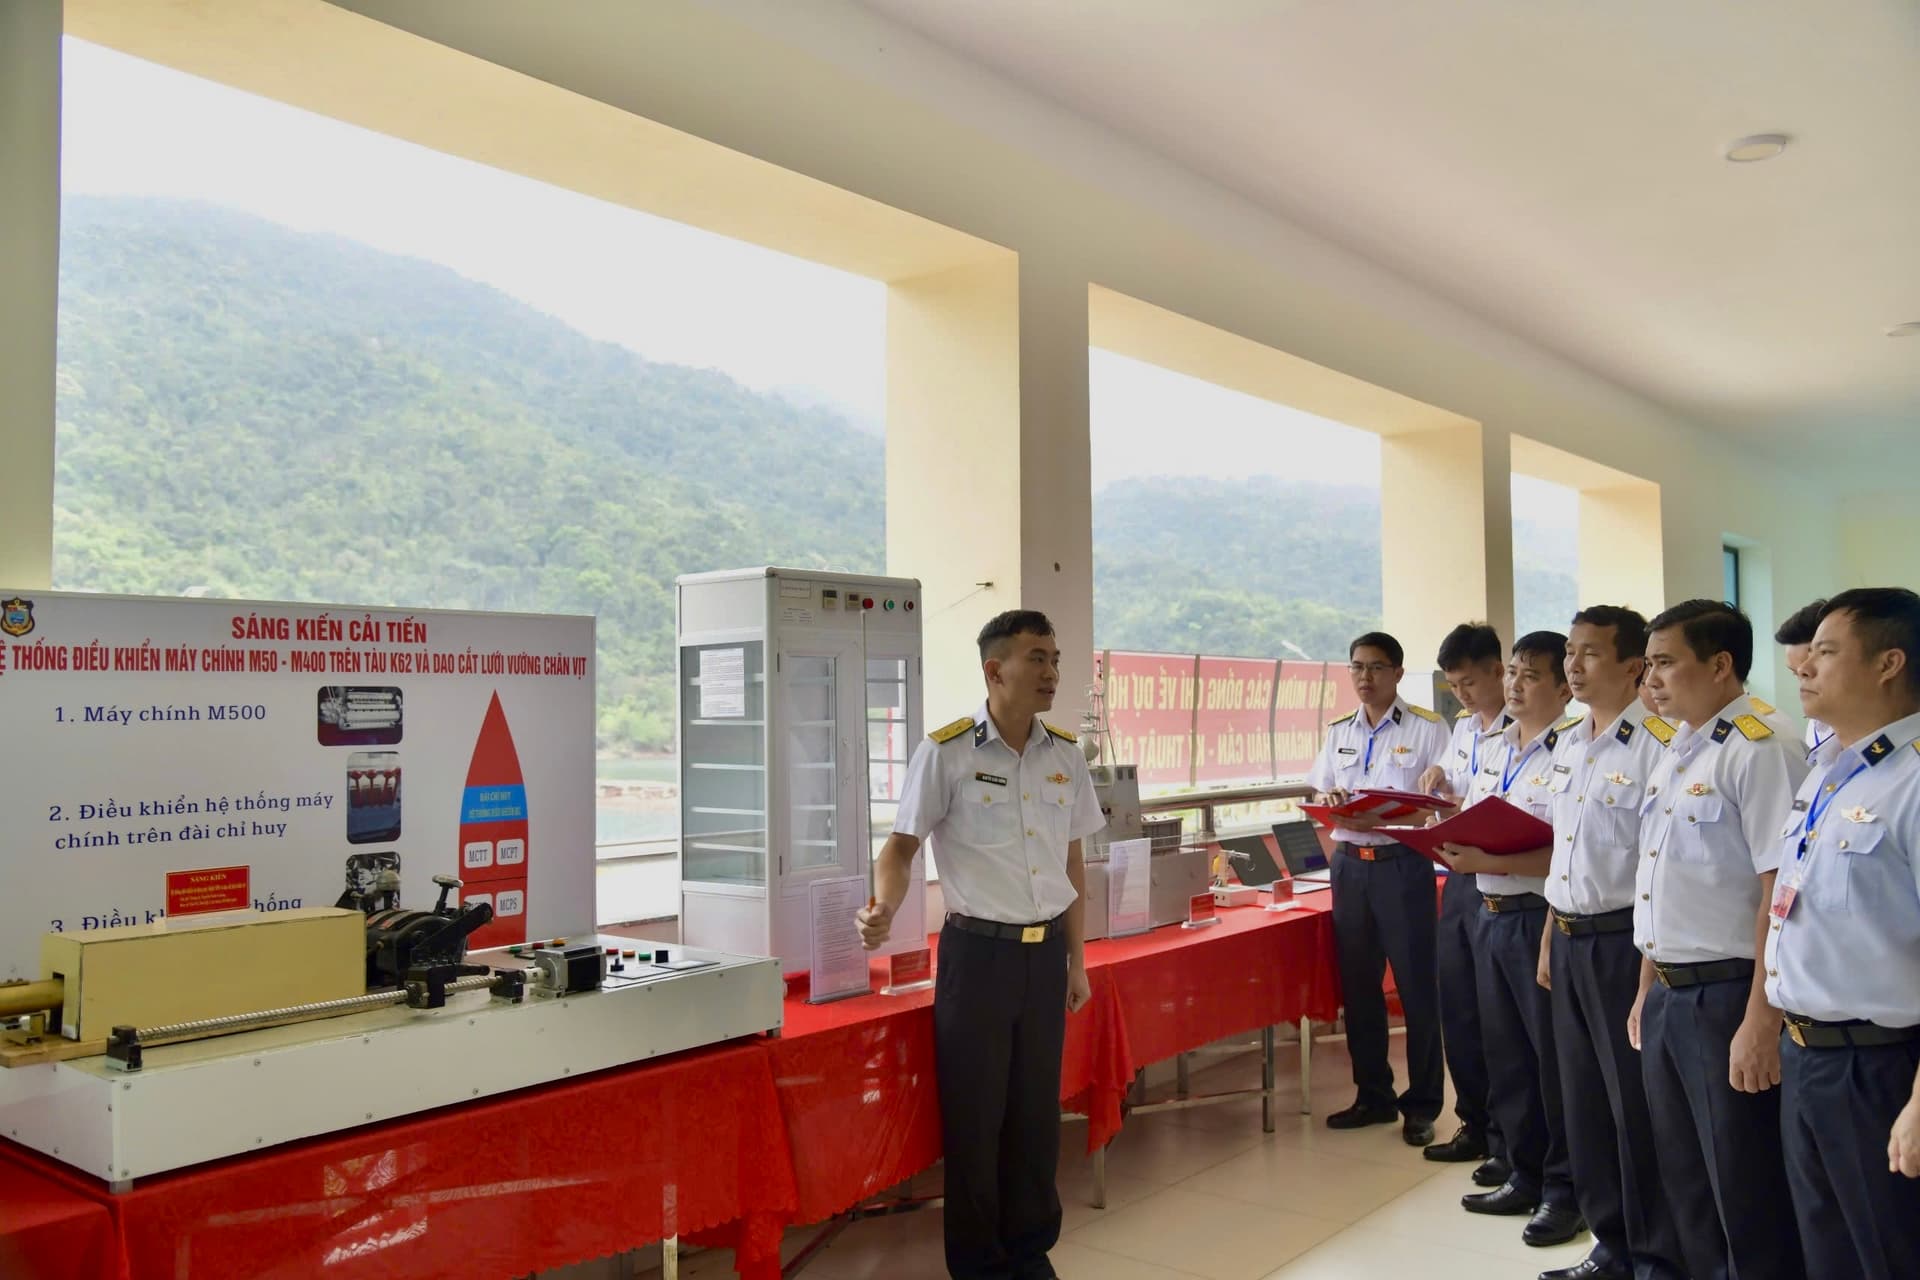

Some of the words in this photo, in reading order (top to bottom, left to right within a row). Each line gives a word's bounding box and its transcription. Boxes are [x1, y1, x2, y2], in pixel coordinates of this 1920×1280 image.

[231, 612, 290, 641] SÁNG
[296, 612, 343, 642] KIẾN
[349, 613, 381, 643] CẢI
[386, 615, 427, 644] TIẾN
[12, 636, 68, 671] THỐNG
[72, 638, 110, 672] ĐIỀU
[114, 637, 160, 672] KHIỂN
[165, 643, 198, 672] MÁY
[202, 644, 245, 672] CHÍNH
[249, 649, 278, 673] M50
[291, 651, 326, 673] M400
[329, 647, 361, 673] TRÊN
[364, 648, 387, 673] TÀU
[390, 652, 413, 674] K62
[415, 649, 430, 674] VÀ
[433, 653, 455, 674] DAO
[458, 645, 479, 675] CẮT
[481, 650, 505, 674] LƯỚI
[543, 652, 570, 676] CHÂN
[572, 656, 587, 681] VỊT
[55, 706, 75, 722] 1.
[83, 705, 133, 725] Máy
[139, 705, 201, 722] chính
[207, 705, 266, 721] M500
[49, 805, 70, 821] 2.
[79, 798, 132, 819] Điều
[138, 794, 199, 816] khiển
[205, 796, 229, 815] hệ
[235, 790, 291, 812] thống
[296, 791, 334, 809] máy
[55, 832, 120, 850] chính
[126, 827, 172, 845] trên
[179, 824, 210, 841] đài
[216, 820, 246, 838] chỉ
[252, 821, 287, 838] huy
[81, 908, 137, 931] Điều
